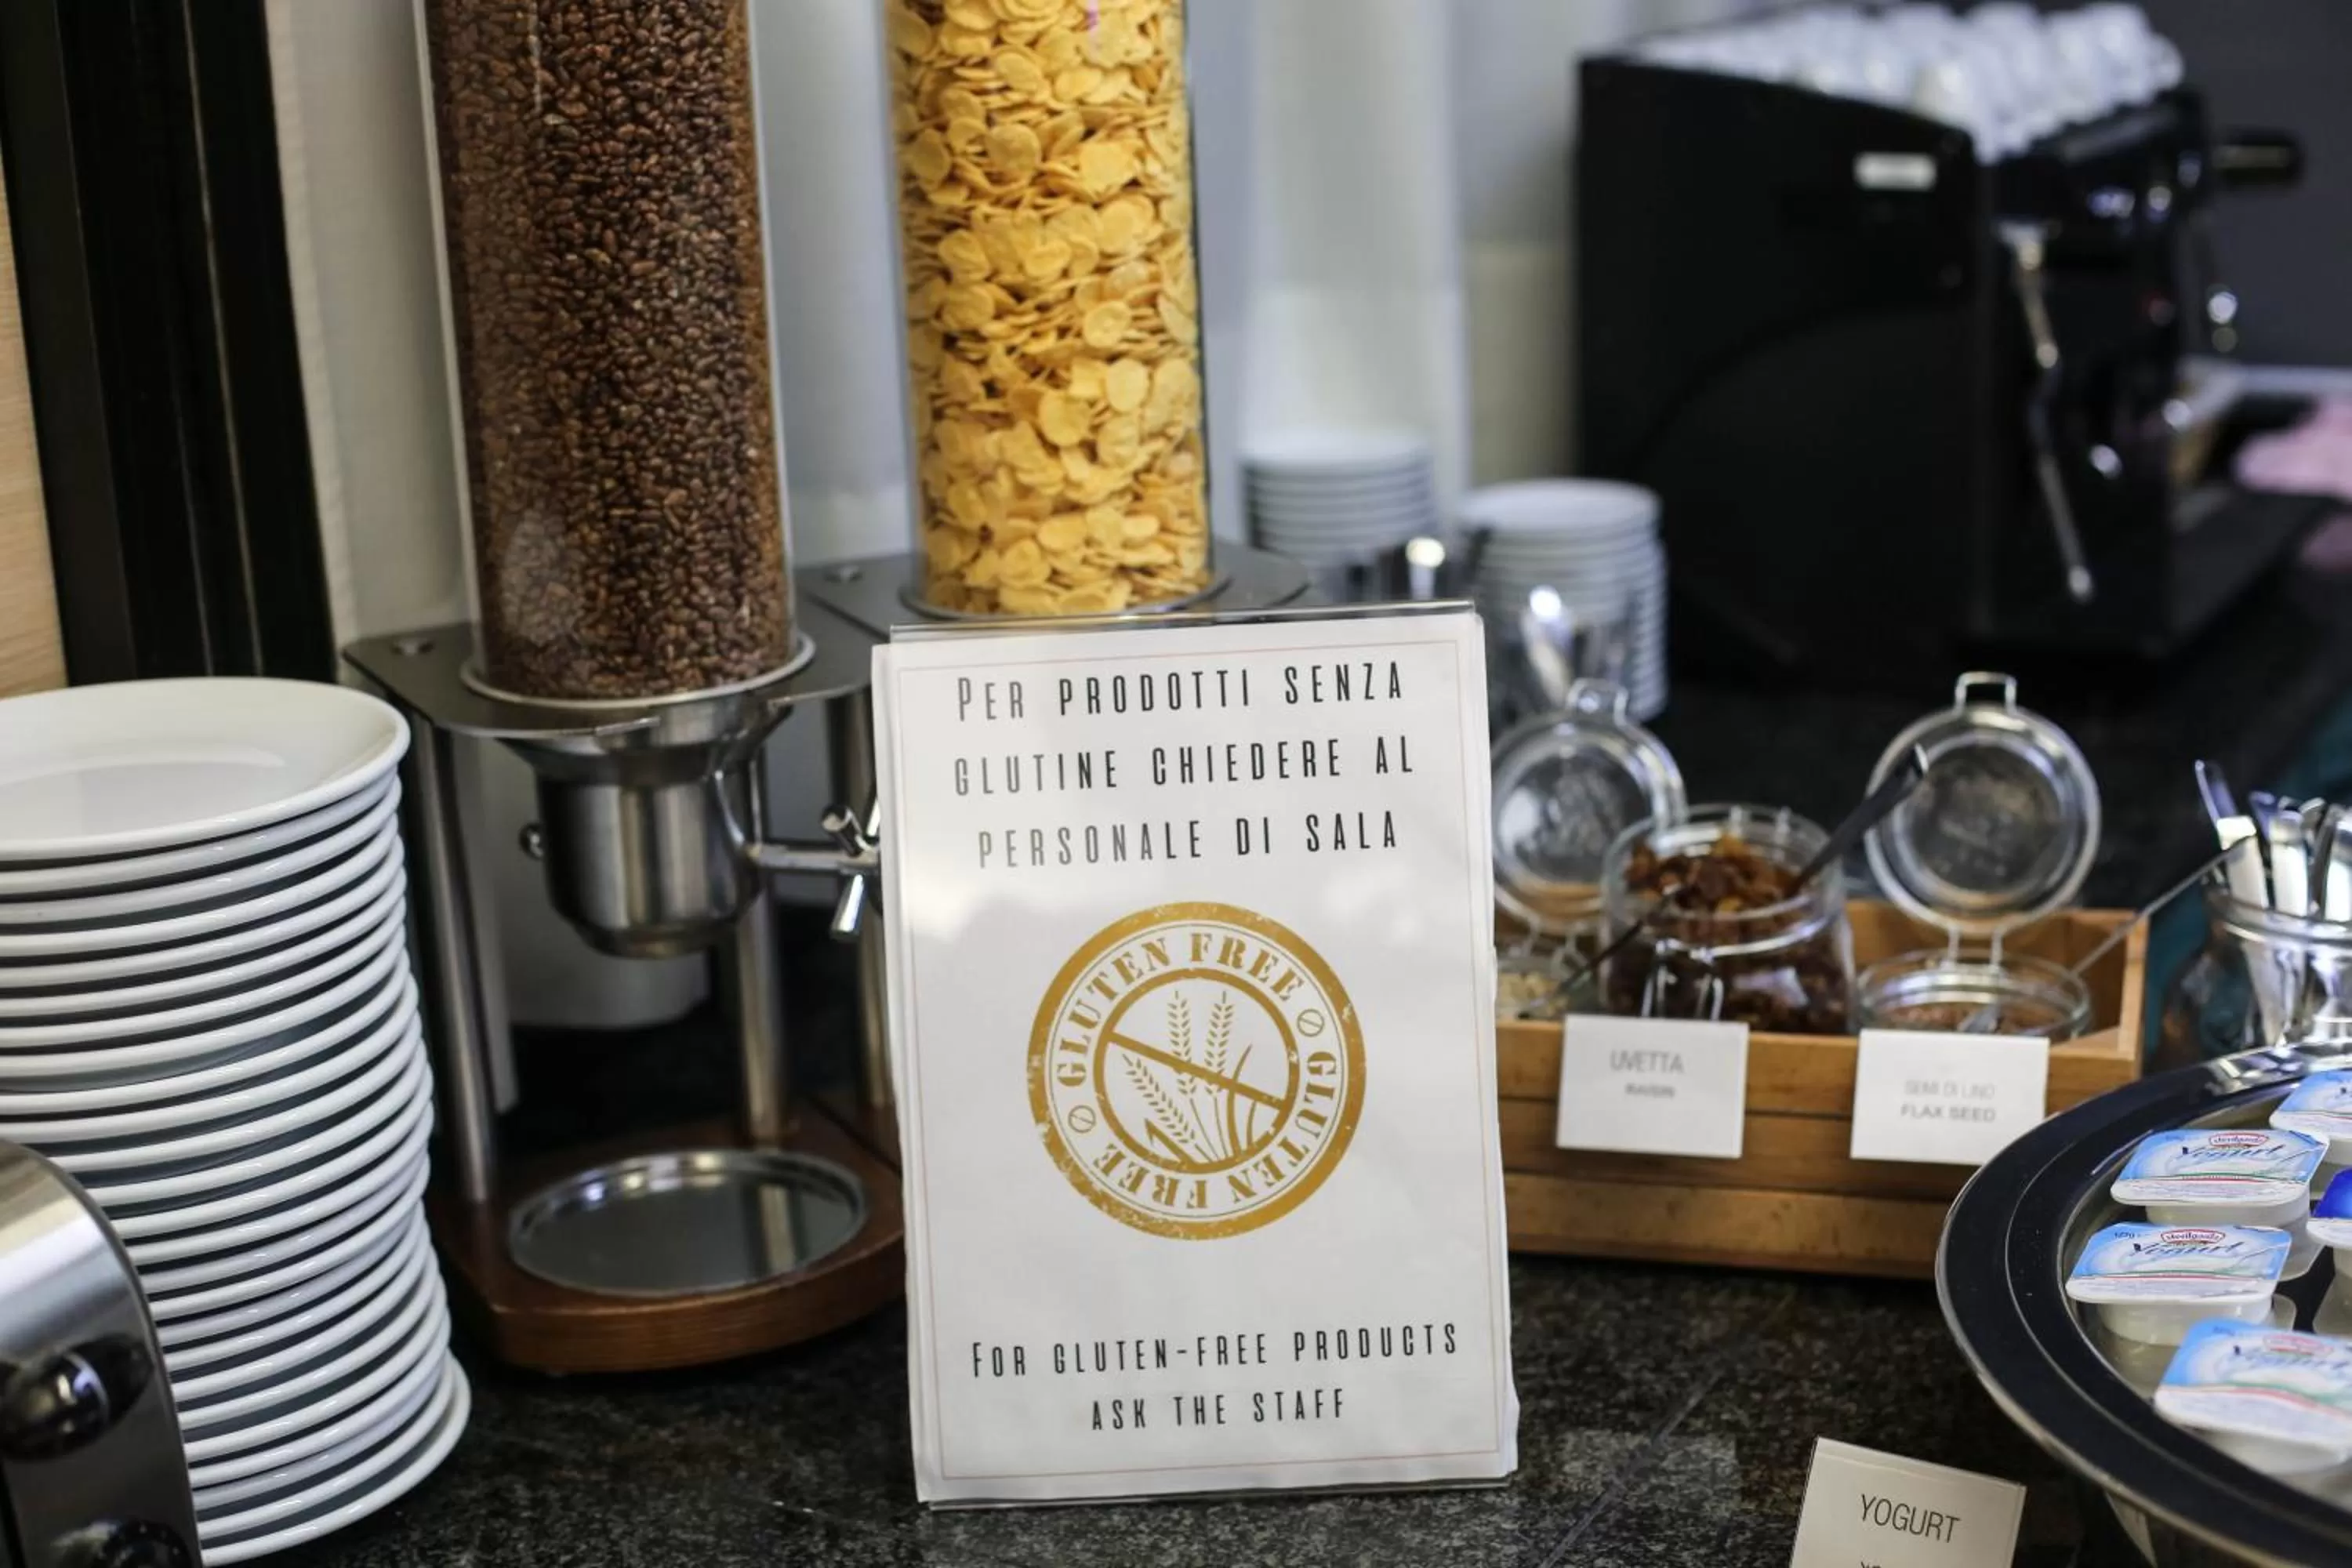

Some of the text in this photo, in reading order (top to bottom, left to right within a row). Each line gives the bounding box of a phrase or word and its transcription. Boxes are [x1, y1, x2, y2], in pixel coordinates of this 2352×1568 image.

[957, 660, 1402, 722] PER PRODOTTI SENZA
[955, 735, 1414, 796] GLUTINE CHIEDERE AL
[978, 810, 1396, 868] PERSONALE DI SALA
[1056, 932, 1305, 1087] GLUTEN FREE
[1610, 1050, 1685, 1073] UVETTA
[1092, 1050, 1338, 1209] GLUTEN FREE
[1900, 1102, 1996, 1121] FLAX SEED
[972, 1323, 1456, 1378] FOR GLUTEN-FREE PRODUCTS
[1092, 1388, 1343, 1431] ASK THE STAFF
[1860, 1494, 1962, 1544] YOGURT
